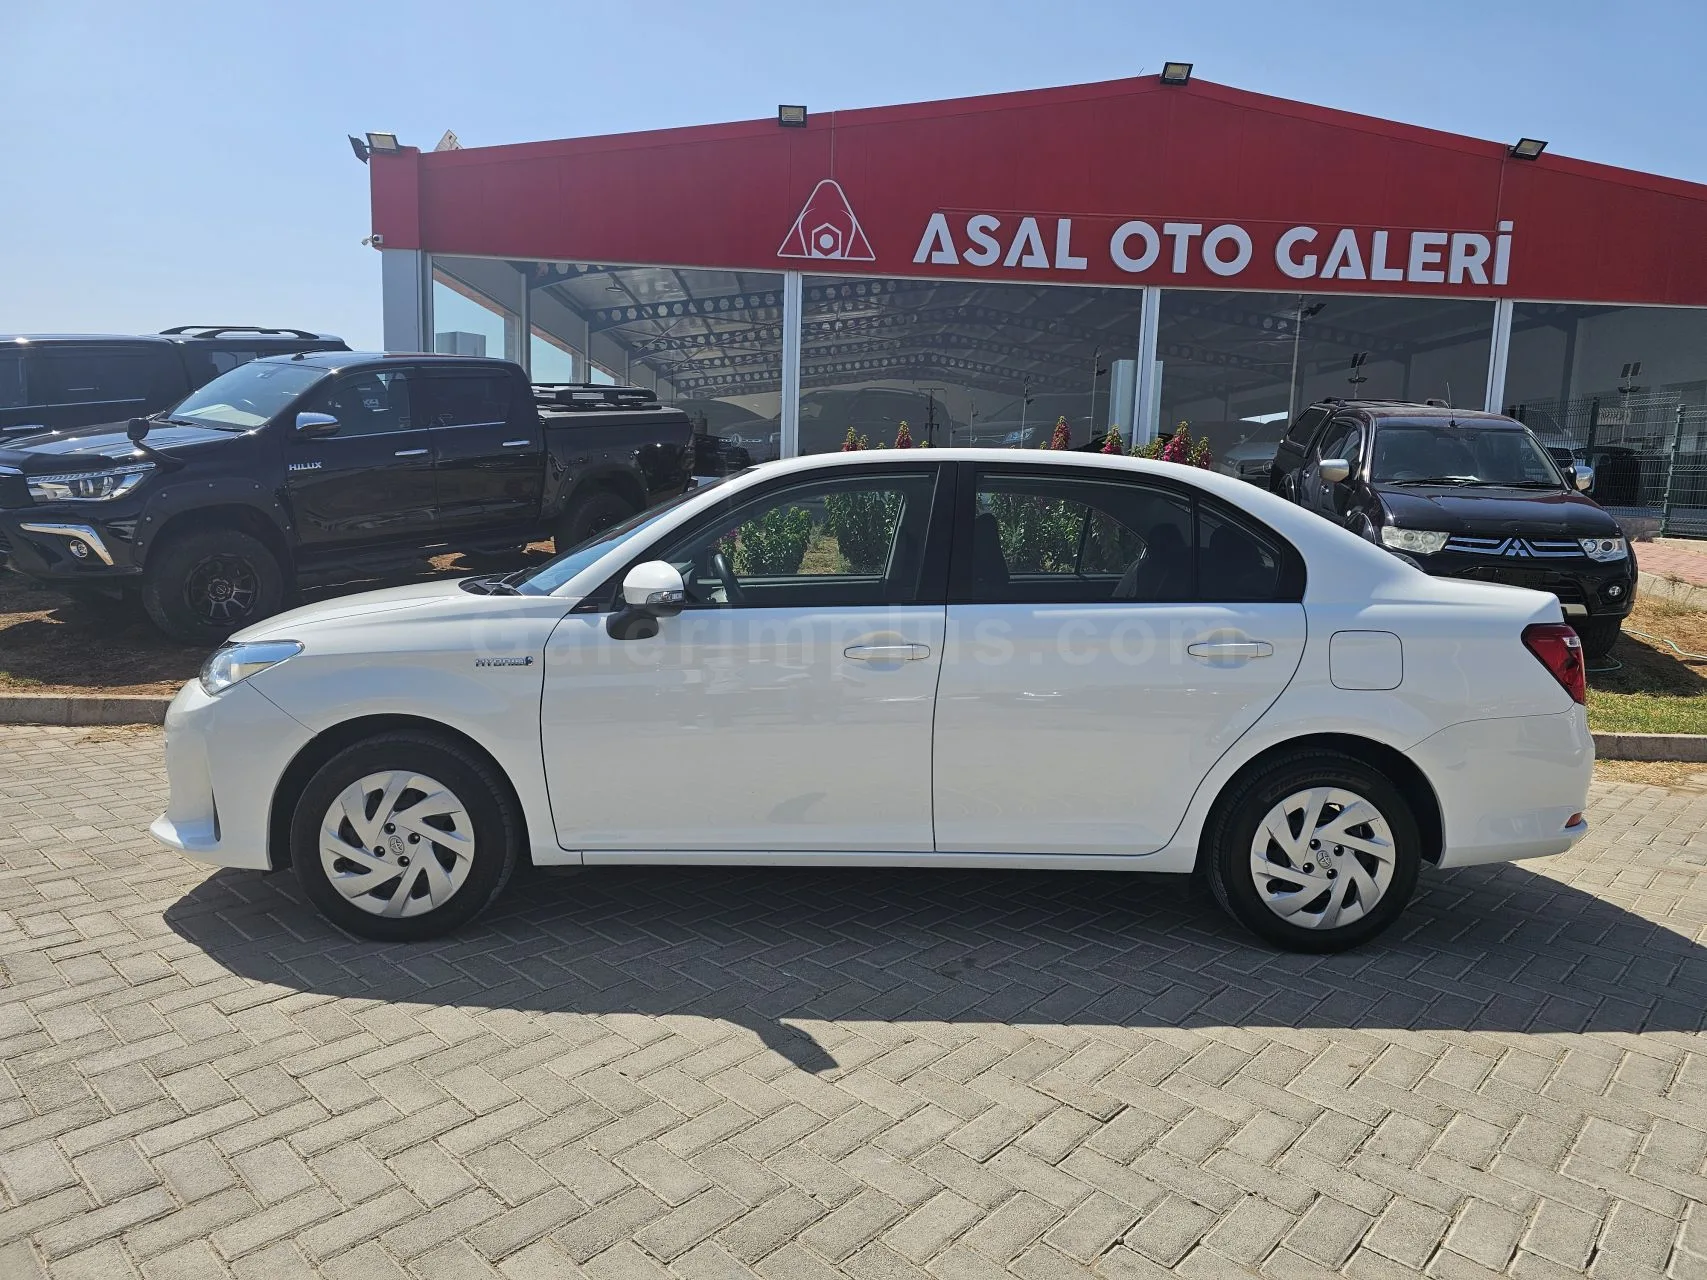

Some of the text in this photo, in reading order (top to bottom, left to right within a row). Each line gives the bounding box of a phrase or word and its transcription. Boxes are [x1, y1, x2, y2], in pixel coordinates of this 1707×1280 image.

[913, 213, 1513, 286] ASAL OTO GALERİ
[288, 461, 322, 471] HILUX
[475, 657, 526, 667] HYBRID
